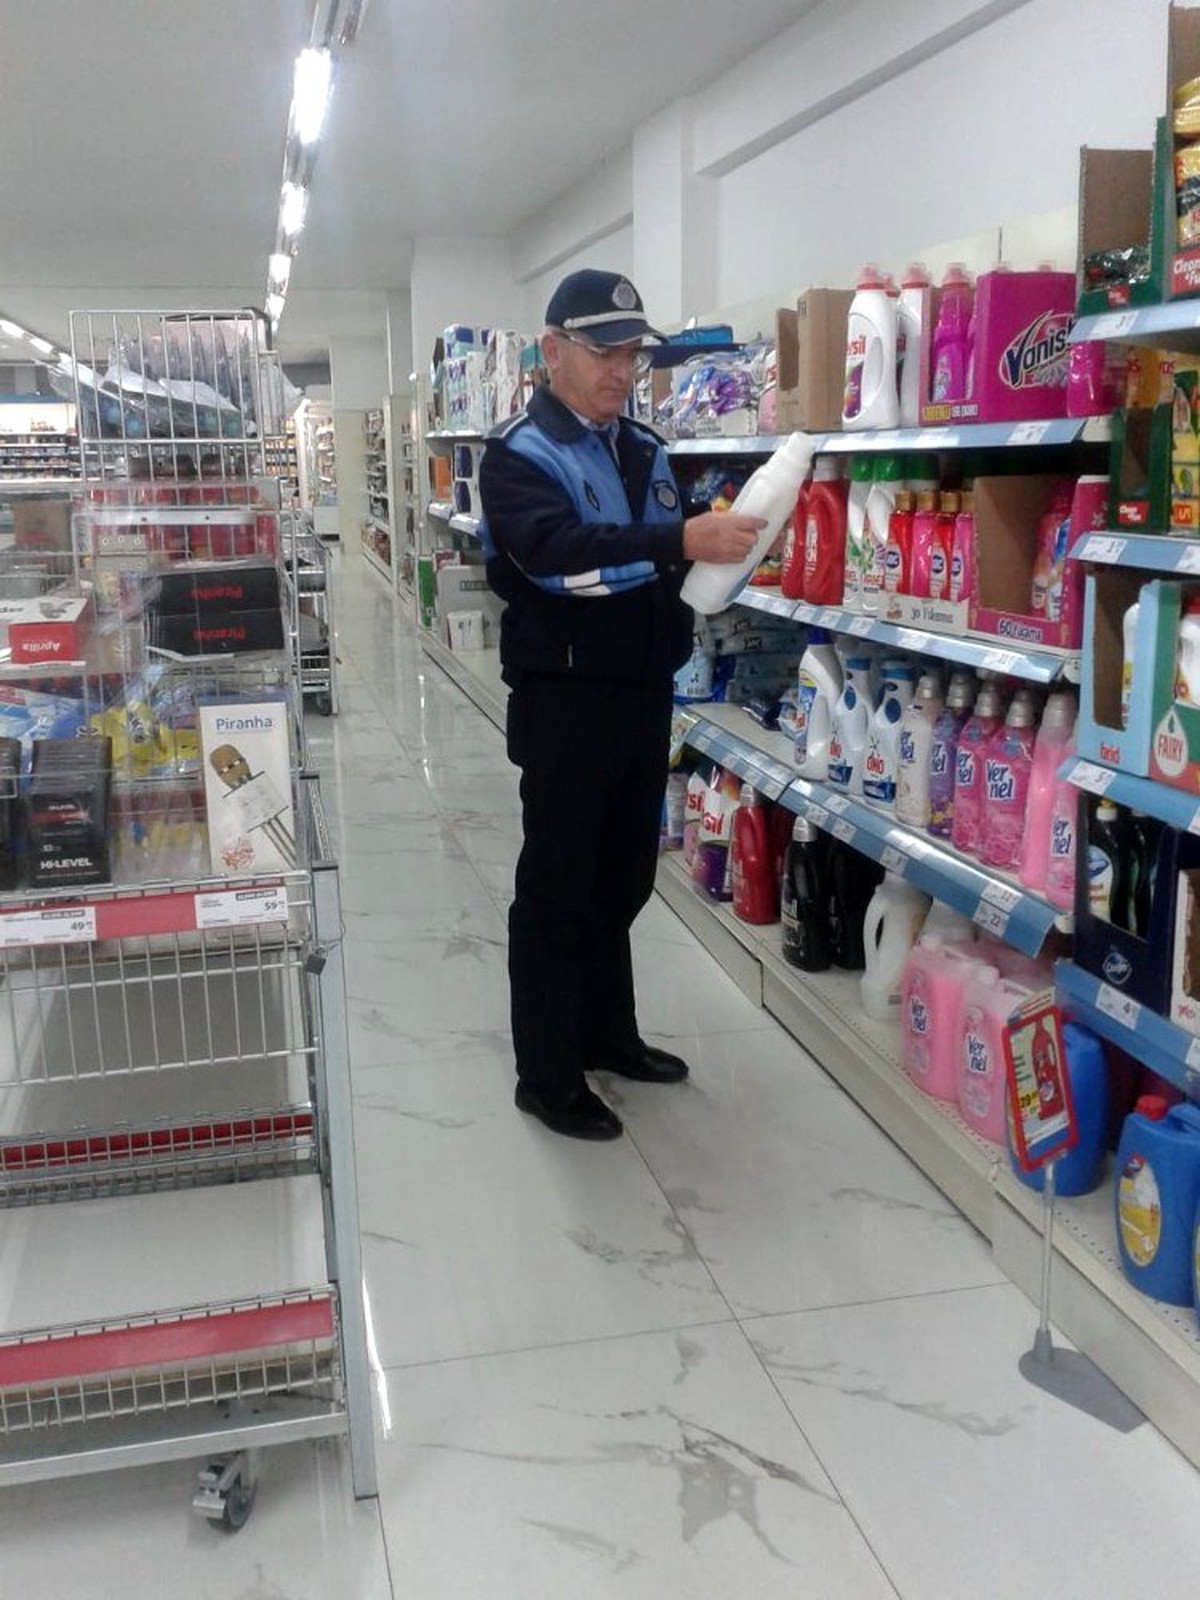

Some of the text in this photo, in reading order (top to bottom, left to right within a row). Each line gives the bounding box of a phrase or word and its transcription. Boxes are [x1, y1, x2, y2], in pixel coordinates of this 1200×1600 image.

[216, 716, 273, 730] Piranha
[987, 761, 1008, 782] Ver
[990, 778, 1013, 798] nel
[40, 857, 93, 869] HI-LEVEL
